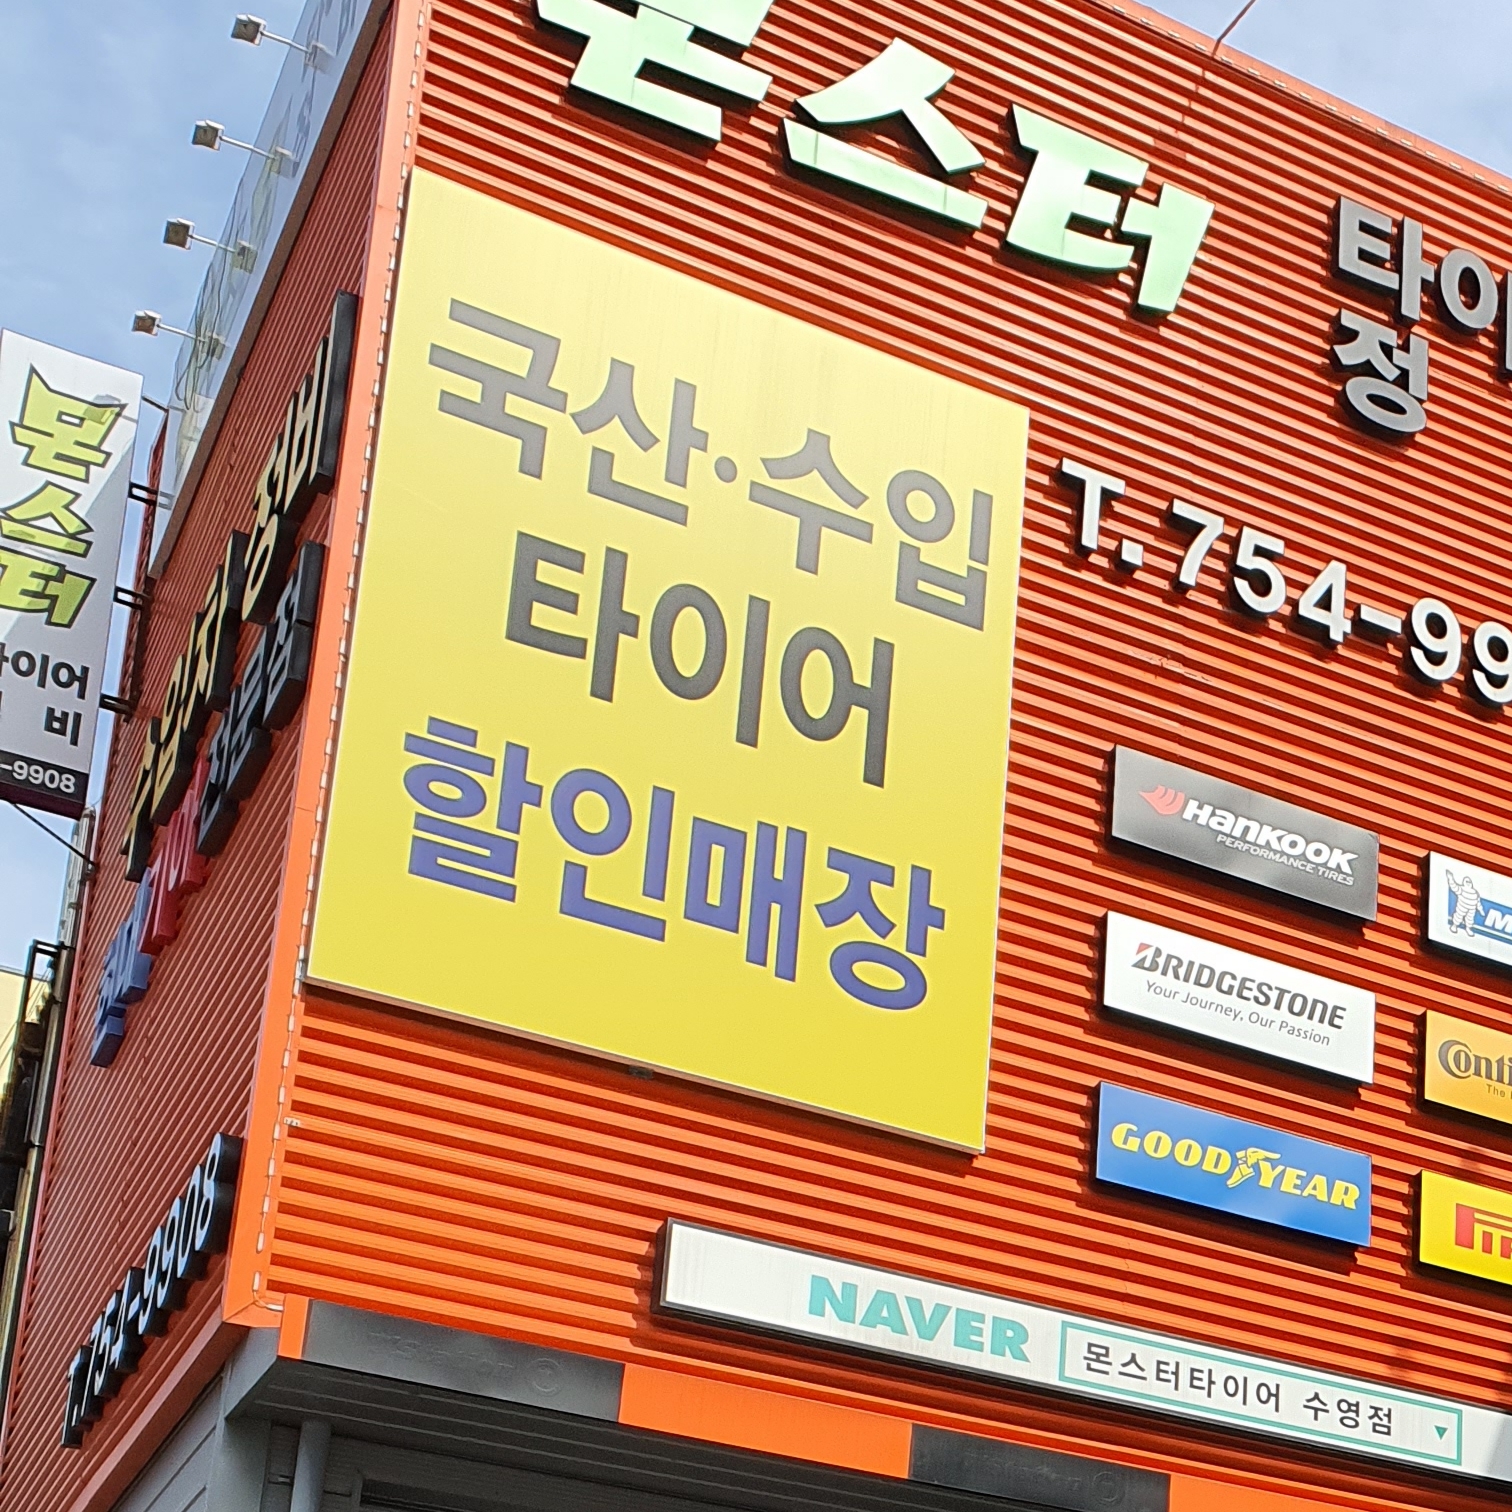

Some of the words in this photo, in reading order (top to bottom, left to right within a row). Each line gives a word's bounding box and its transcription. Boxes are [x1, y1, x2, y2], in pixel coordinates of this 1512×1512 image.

[0, 362, 128, 630] 몬스터
[120, 532, 240, 856] 수입차
[505, 530, 895, 788] 타이어
[401, 716, 946, 1012] 할인매장
[1216, 833, 1314, 874] PERFORMANCE
[1317, 865, 1355, 886] TIRES
[1131, 942, 1347, 1030] BRIDGESTONE
[1146, 979, 1181, 1001] Your
[1181, 991, 1245, 1022] Journey,
[1248, 1010, 1276, 1030] Our
[1278, 1020, 1331, 1047] Passion
[1486, 1083, 1506, 1098] The
[809, 1275, 1031, 1364] NAVER
[1082, 1341, 1283, 1415] 몬스터타이어
[1302, 1388, 1395, 1438] 수영점
